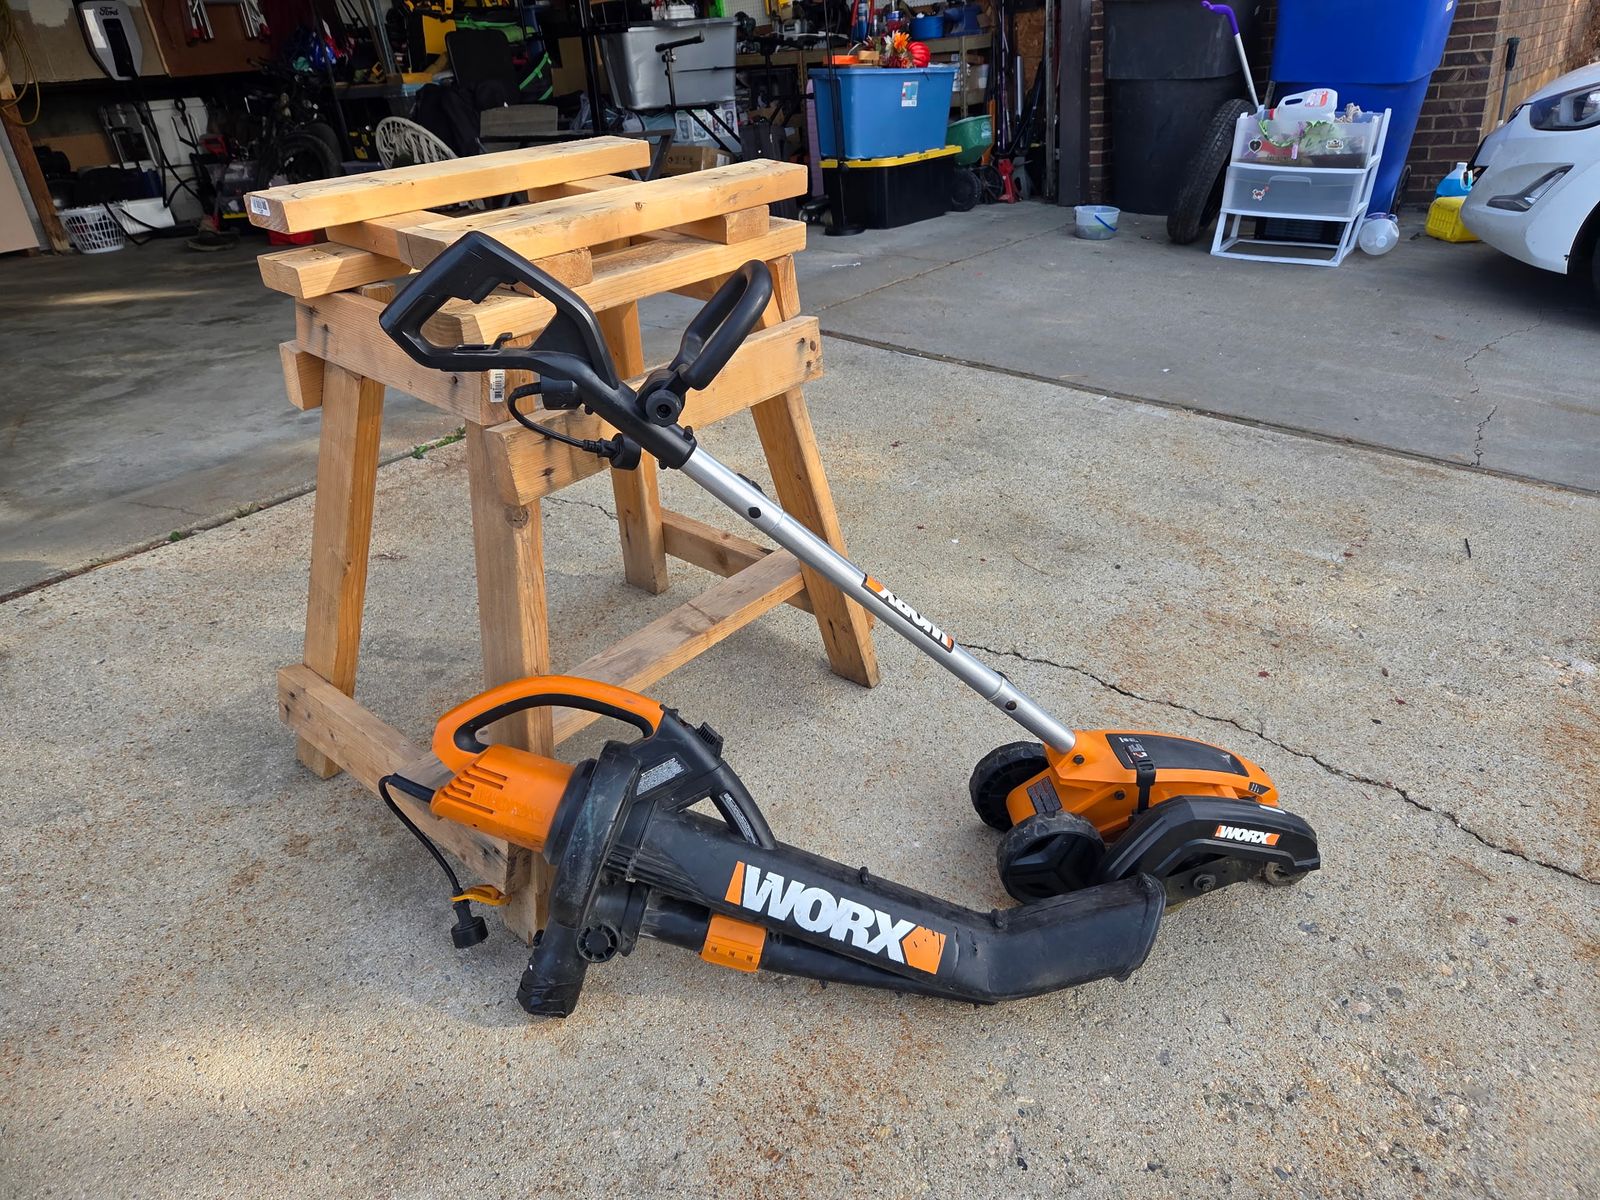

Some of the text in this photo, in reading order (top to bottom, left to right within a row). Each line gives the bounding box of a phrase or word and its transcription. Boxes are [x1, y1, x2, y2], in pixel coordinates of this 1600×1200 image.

[100, 6, 119, 16] Ford
[1218, 825, 1270, 845] WORX
[742, 864, 917, 964] WORX
